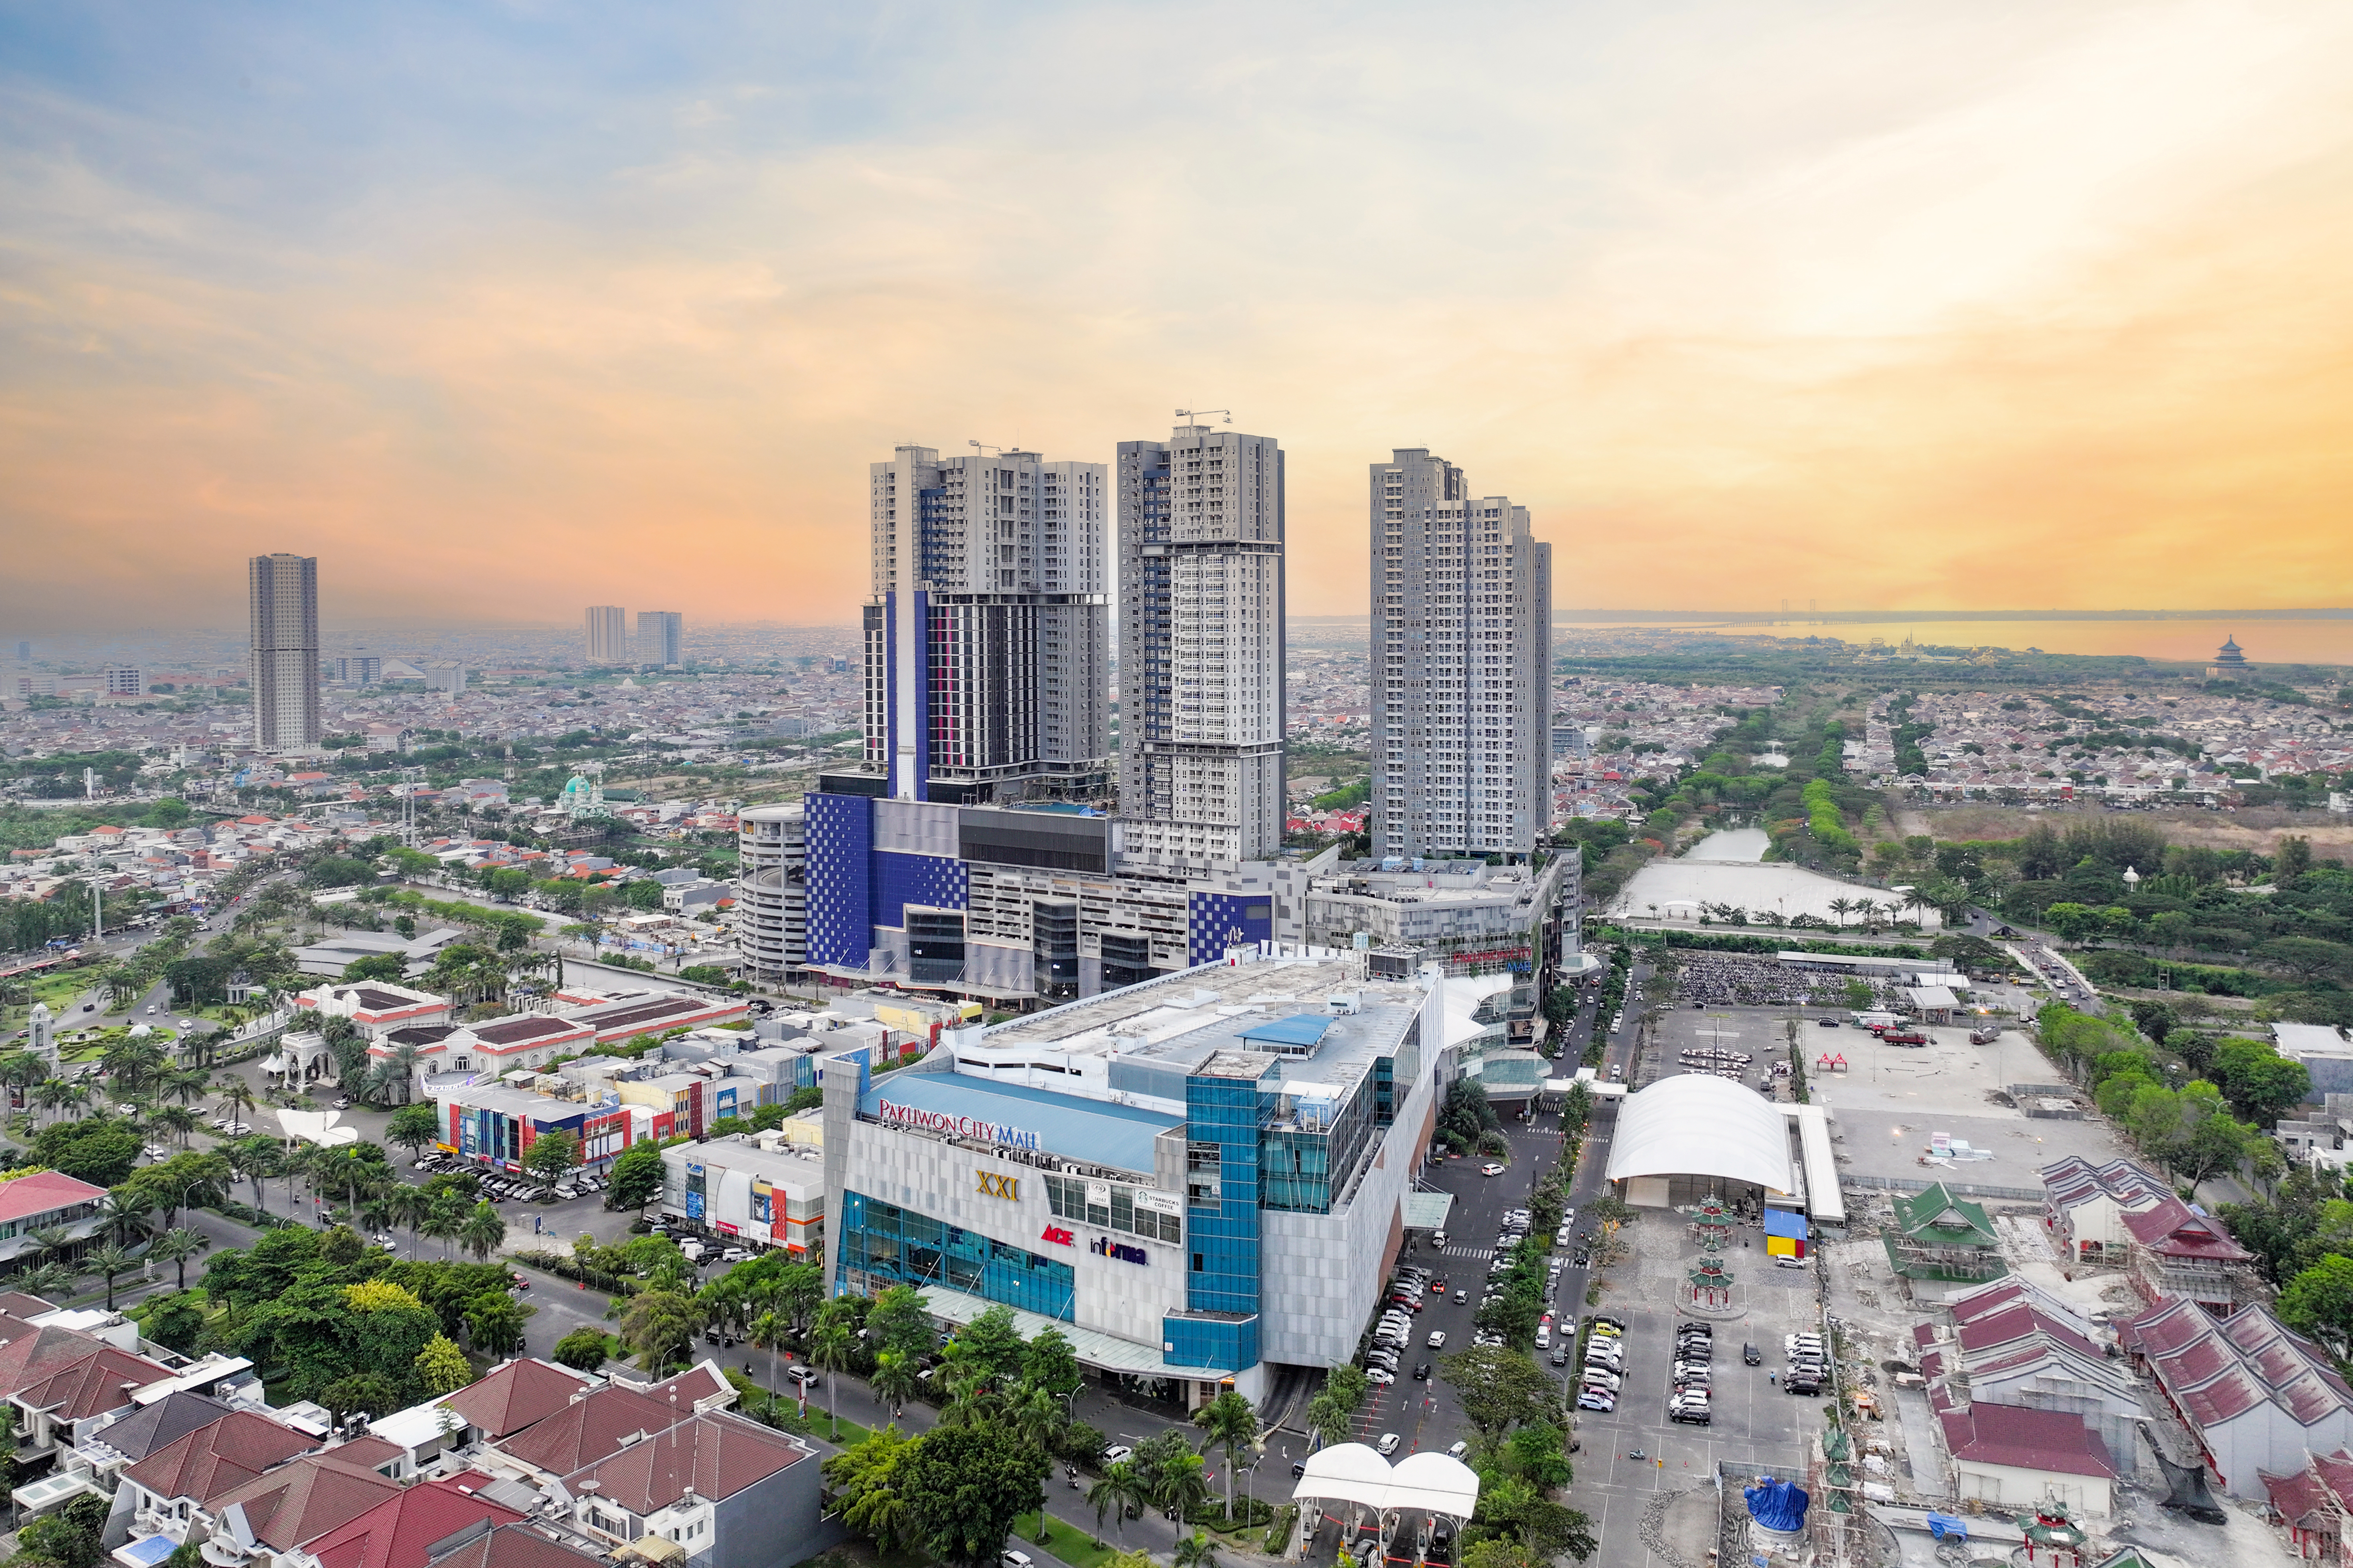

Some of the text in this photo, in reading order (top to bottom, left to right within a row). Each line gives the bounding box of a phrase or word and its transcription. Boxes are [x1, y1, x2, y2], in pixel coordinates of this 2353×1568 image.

[1454, 947, 1532, 963] PAKUWON CITY
[1507, 961, 1532, 972] MALL
[430, 1082, 463, 1092] ACADEMY
[880, 1099, 1038, 1150] PAKUWON CITY MALL
[976, 1170, 1018, 1201] XXI
[1149, 1196, 1179, 1206] STARBUCKS
[1041, 1223, 1073, 1247] ACE
[1090, 1237, 1146, 1265] informa
